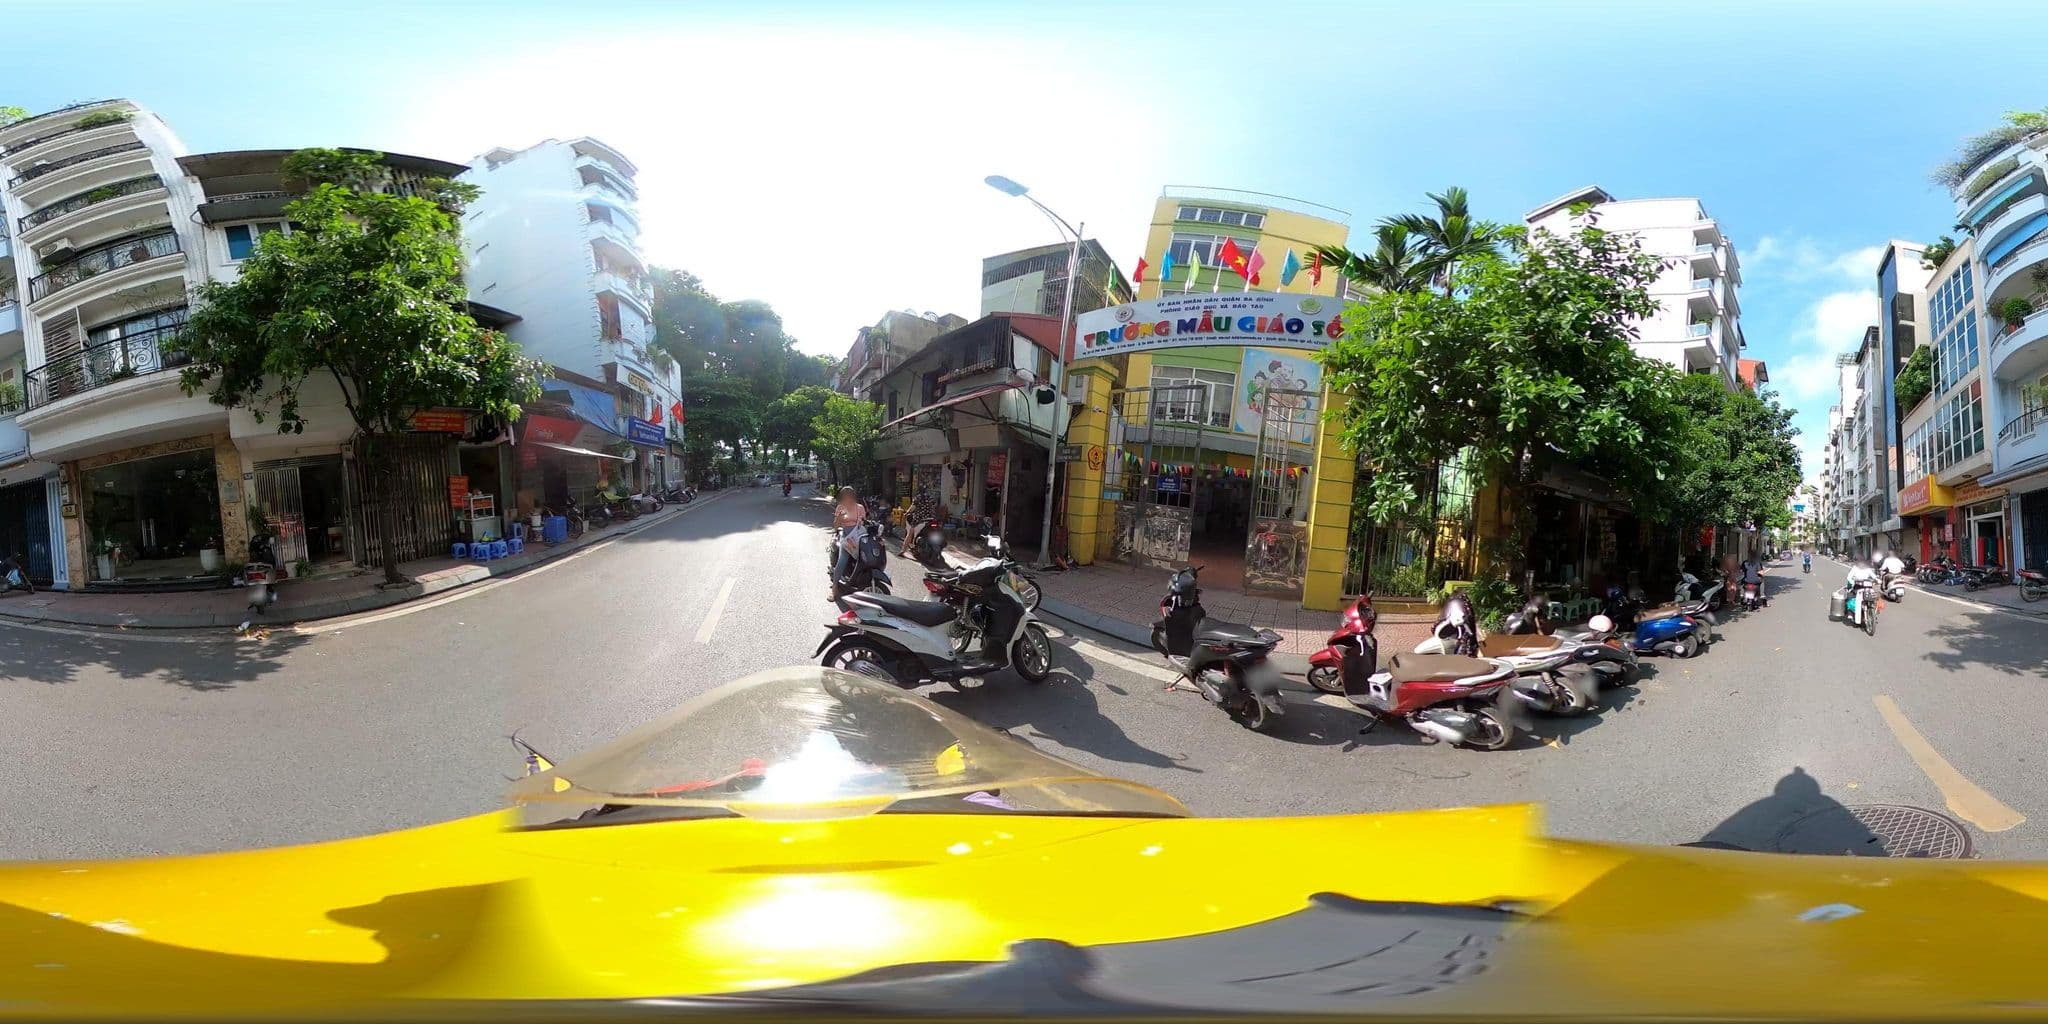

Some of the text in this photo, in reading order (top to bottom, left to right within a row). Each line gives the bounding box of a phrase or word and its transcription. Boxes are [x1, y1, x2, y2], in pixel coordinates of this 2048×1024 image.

[1083, 320, 1171, 348] TRƯỜNG
[1176, 310, 1233, 335] MẪU
[1237, 313, 1304, 334] GIÁO
[1311, 314, 1345, 339] SỐ
